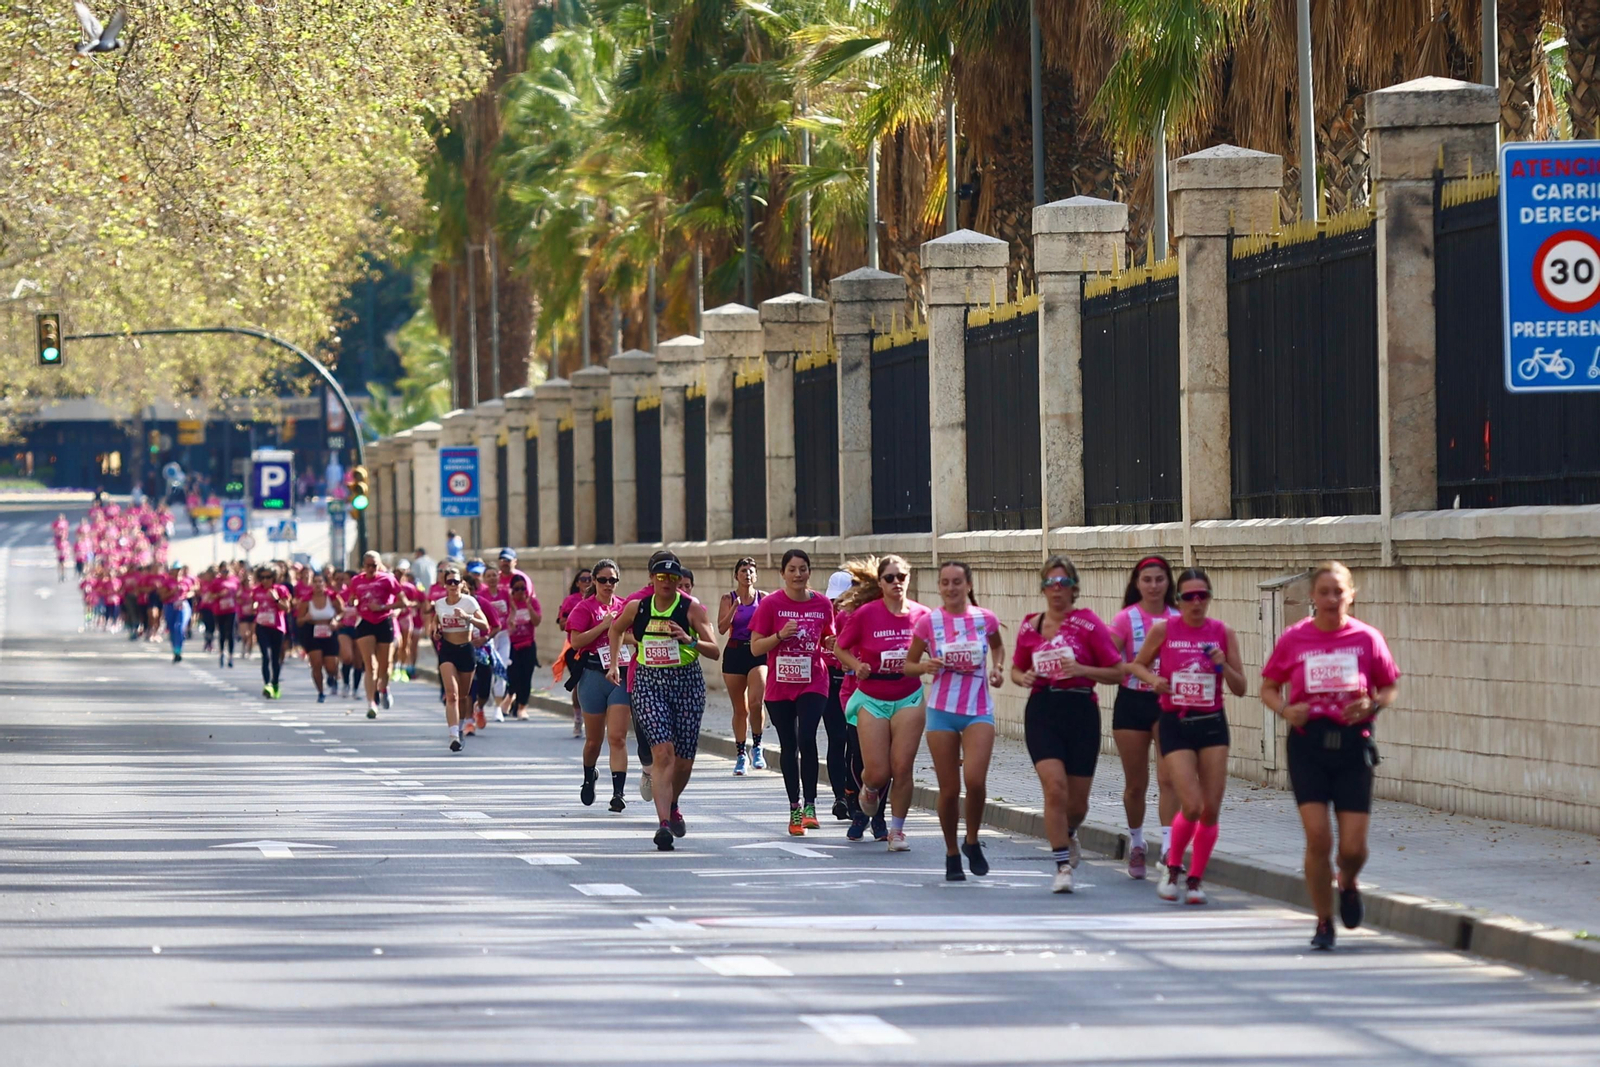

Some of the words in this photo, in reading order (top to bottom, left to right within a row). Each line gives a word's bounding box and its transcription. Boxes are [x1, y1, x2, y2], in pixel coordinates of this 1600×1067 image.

[1550, 257, 1594, 285] 30
[260, 465, 287, 498] P
[778, 610, 799, 618] CARRERA
[804, 611, 825, 619] MUJERES
[873, 629, 896, 638] CARRERA
[646, 647, 668, 658] 3588
[946, 651, 971, 663] 3070
[779, 664, 800, 674] 2330
[1038, 659, 1062, 672] 2371
[1180, 683, 1200, 695] 632
